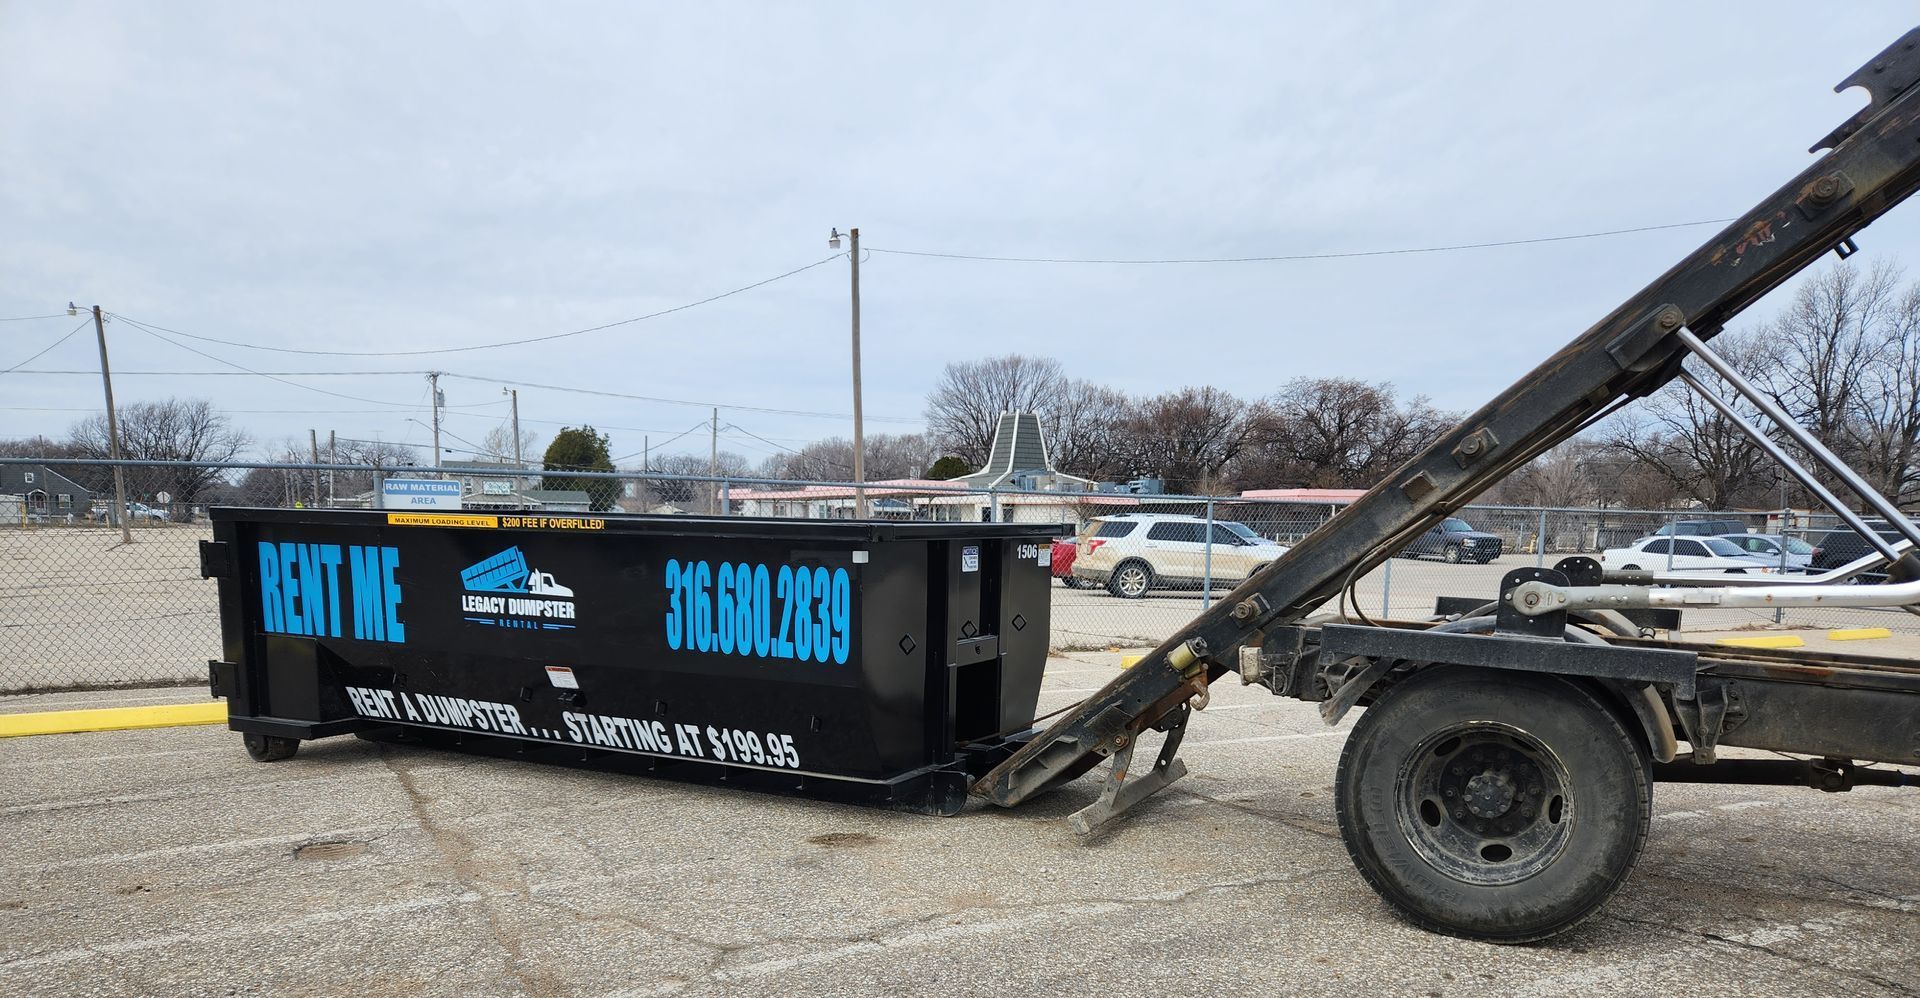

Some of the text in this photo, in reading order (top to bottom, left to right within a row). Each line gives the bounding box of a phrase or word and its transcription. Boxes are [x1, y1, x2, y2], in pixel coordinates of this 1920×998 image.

[385, 482, 460, 493] RAW MATERIAL
[410, 497, 437, 505] AREA
[394, 517, 491, 527] MAXIMUM LOADING LEVEL
[502, 517, 605, 530] $200 FEE IF OVERFILLED!
[1016, 543, 1038, 559] 1506
[258, 541, 405, 643] RENT ME
[462, 595, 576, 619] LEGACY DUMPSTER
[665, 558, 850, 664] 316.680.2839
[499, 619, 538, 629] RENTAL
[345, 686, 401, 720] RENT
[400, 692, 422, 722] A
[562, 710, 673, 754] STARTING
[674, 723, 705, 757] AT
[706, 725, 800, 768] $199.95
